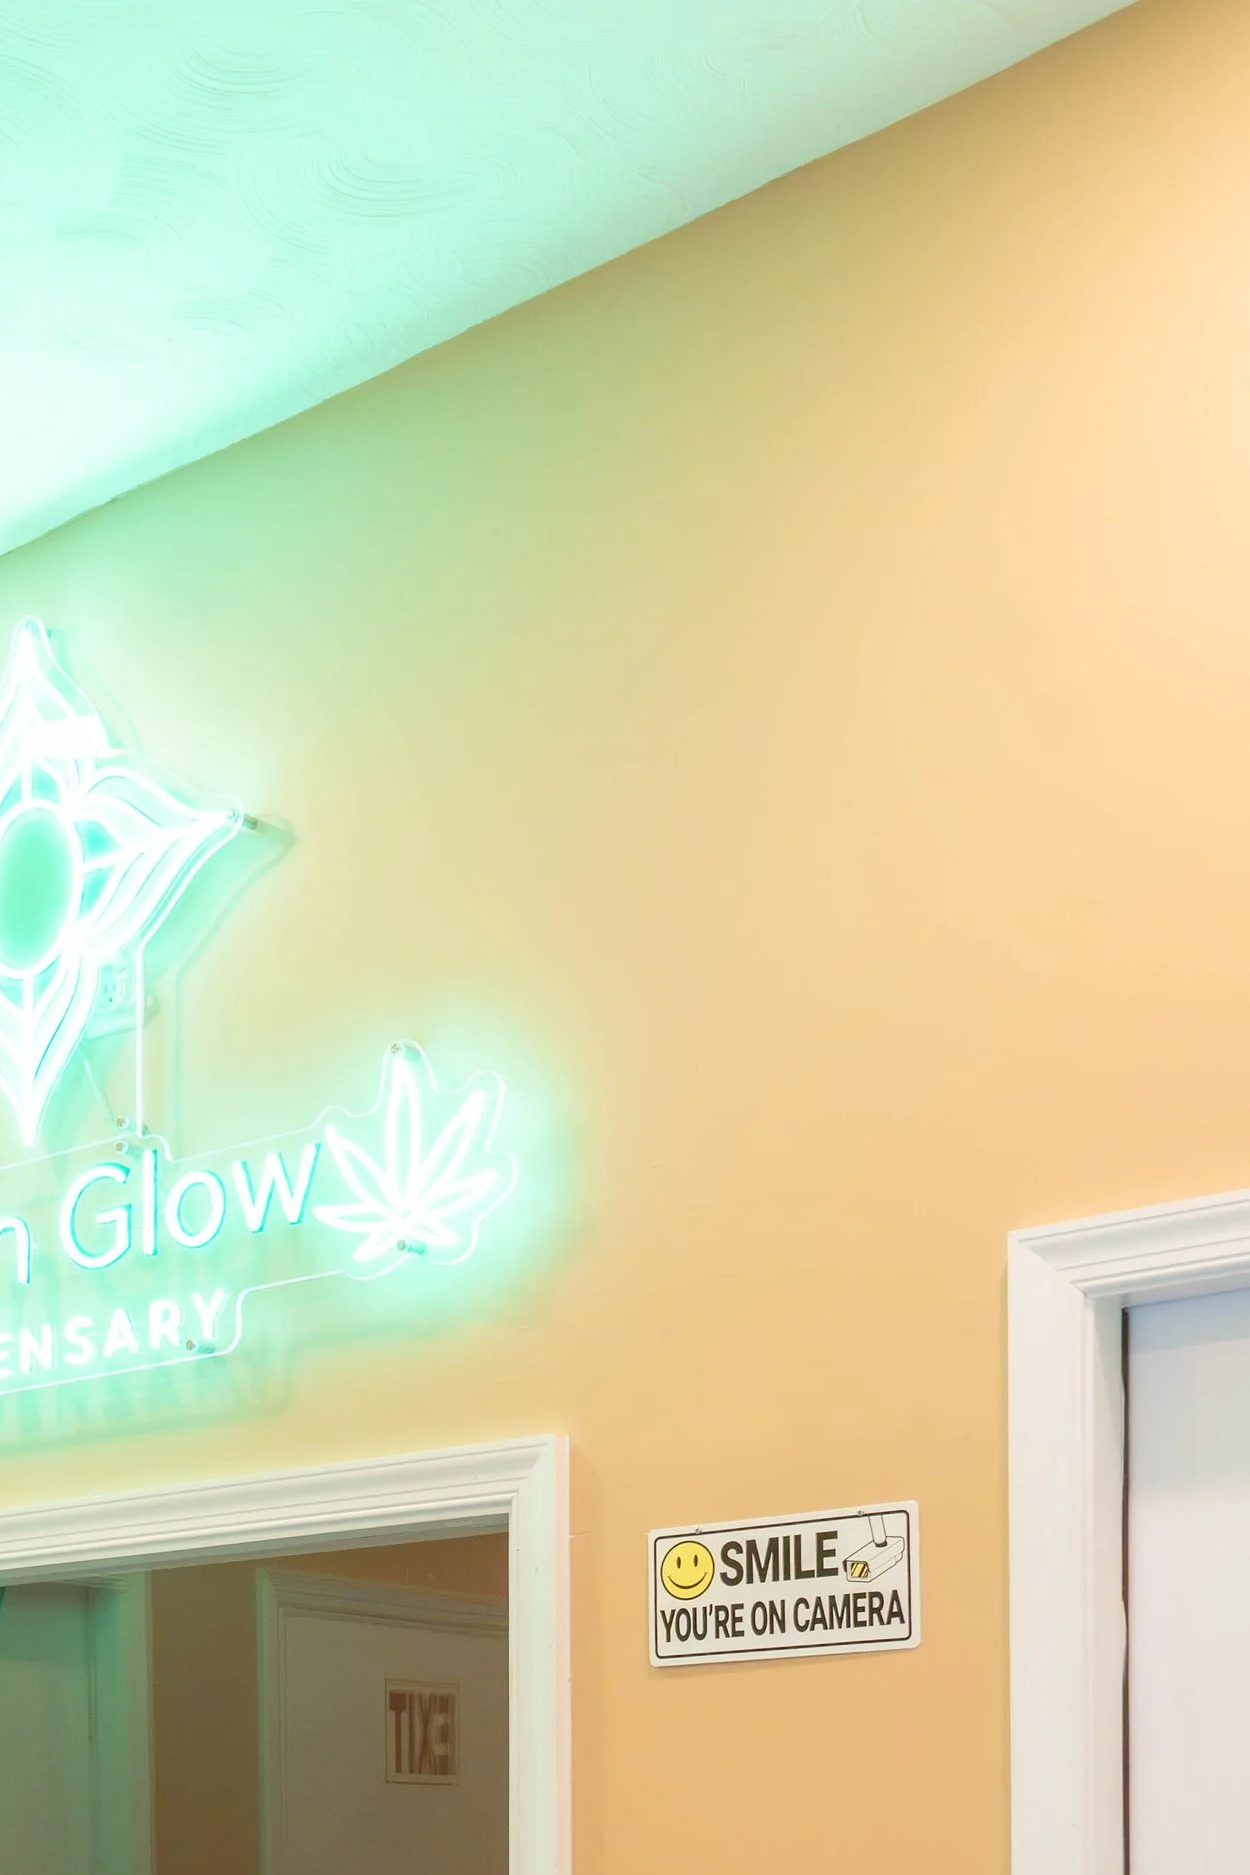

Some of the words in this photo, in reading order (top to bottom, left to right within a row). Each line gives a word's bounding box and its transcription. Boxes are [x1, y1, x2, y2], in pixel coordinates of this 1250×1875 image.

[59, 1143, 322, 1268] Glow
[720, 1531, 838, 1586] SMILE
[660, 1603, 745, 1642] YOU'RE
[750, 1600, 785, 1636] ON
[793, 1589, 905, 1632] CAMERA
